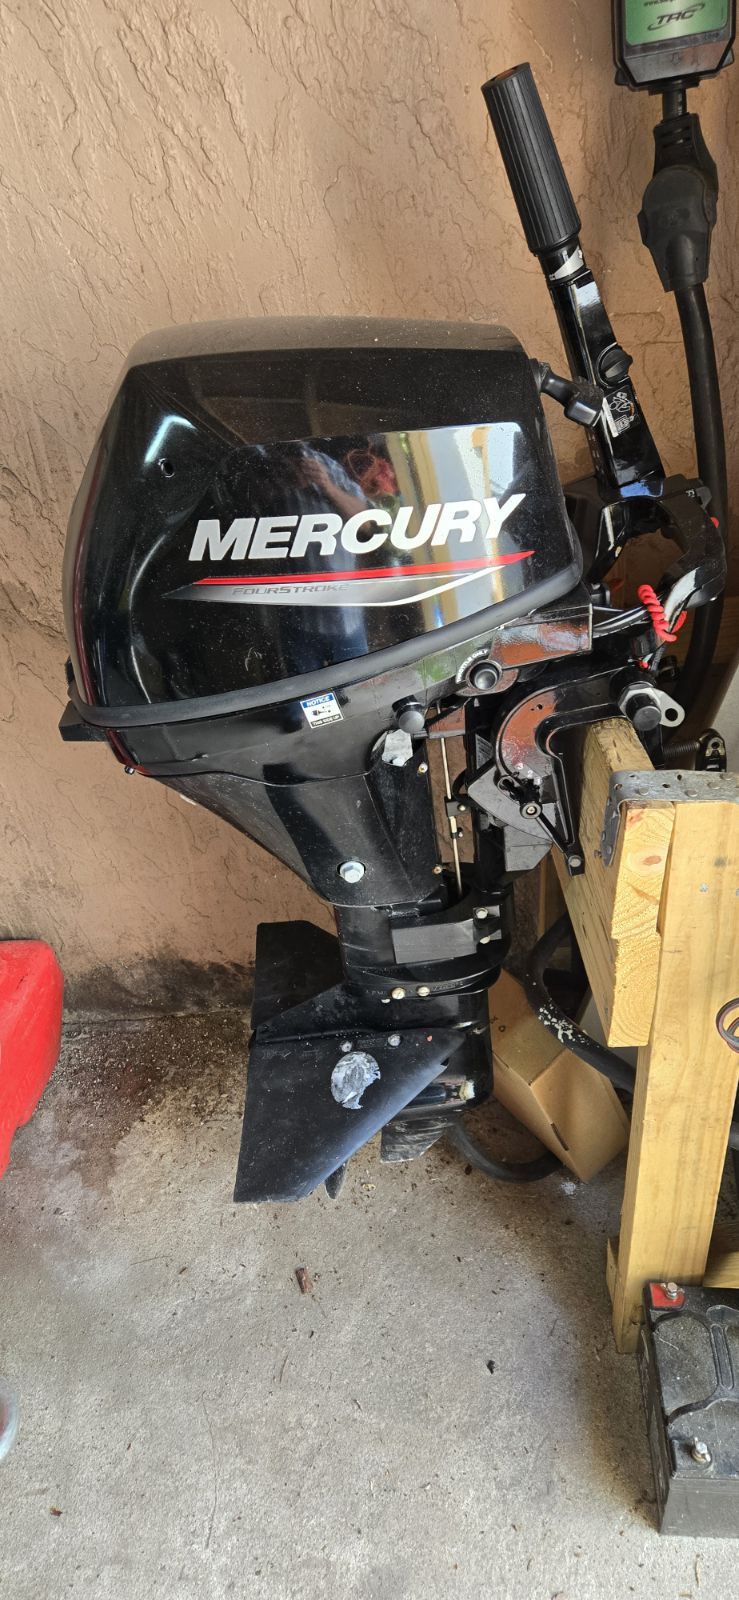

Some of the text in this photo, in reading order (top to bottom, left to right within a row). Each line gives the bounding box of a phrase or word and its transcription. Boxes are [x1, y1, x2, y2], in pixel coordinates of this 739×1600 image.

[188, 493, 526, 562] MERCURY
[232, 584, 350, 596] FOURSTROKE
[472, 648, 489, 658] ONLY
[306, 695, 331, 707] NOTICE
